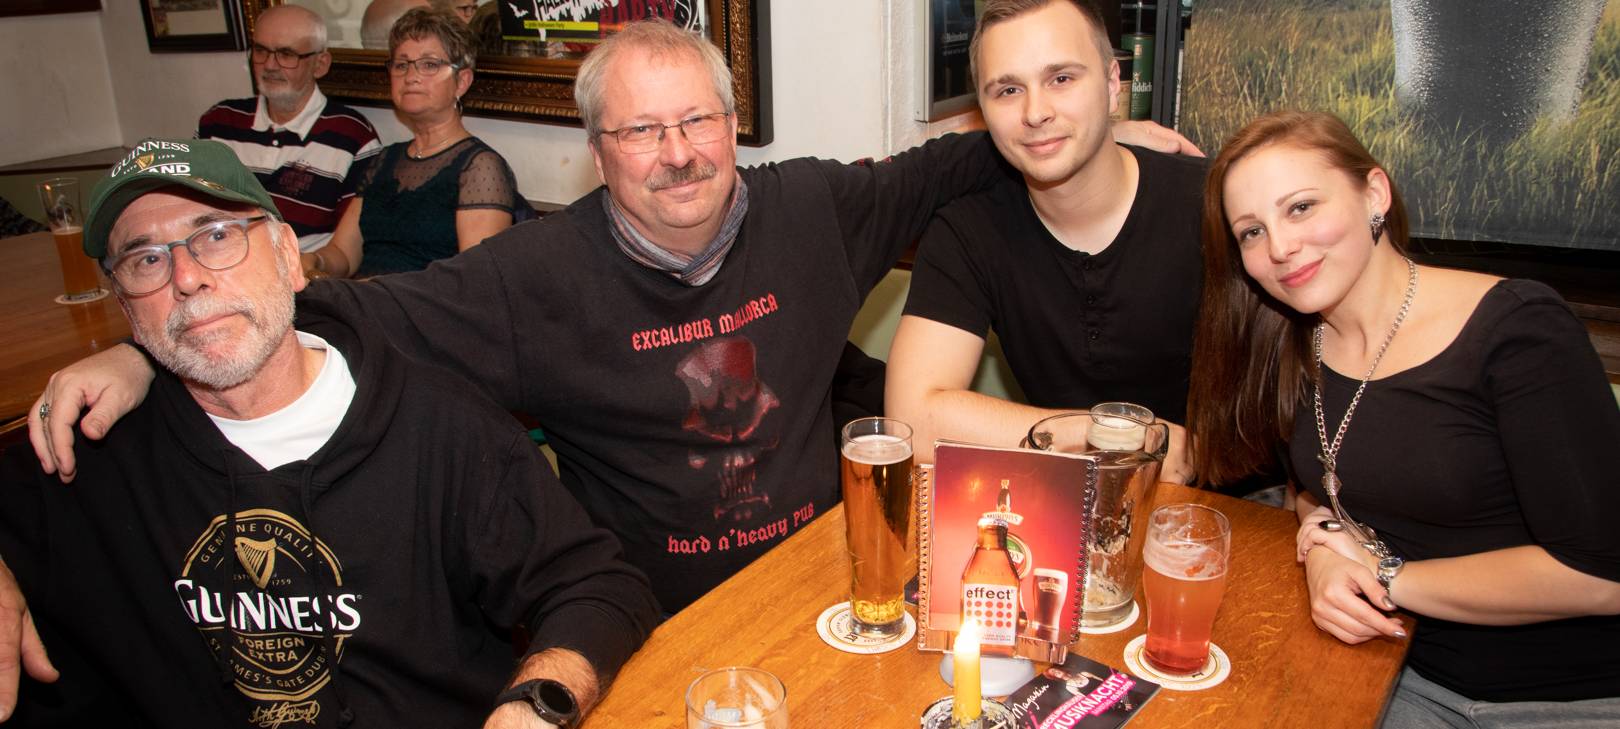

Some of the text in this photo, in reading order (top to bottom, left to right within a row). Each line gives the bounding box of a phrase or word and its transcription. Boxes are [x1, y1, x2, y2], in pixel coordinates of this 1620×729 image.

[111, 140, 190, 178] GUINNESS
[631, 292, 779, 352] EXCALIBUR MALLORCA
[667, 534, 712, 555] hard
[793, 501, 815, 528] PUB
[174, 579, 361, 633] GUINNESS
[966, 587, 1012, 600] effect
[238, 636, 305, 651] FOREIGN
[248, 649, 299, 663] EXTRA
[276, 674, 305, 688] GATE
[1012, 684, 1050, 719] Magazin
